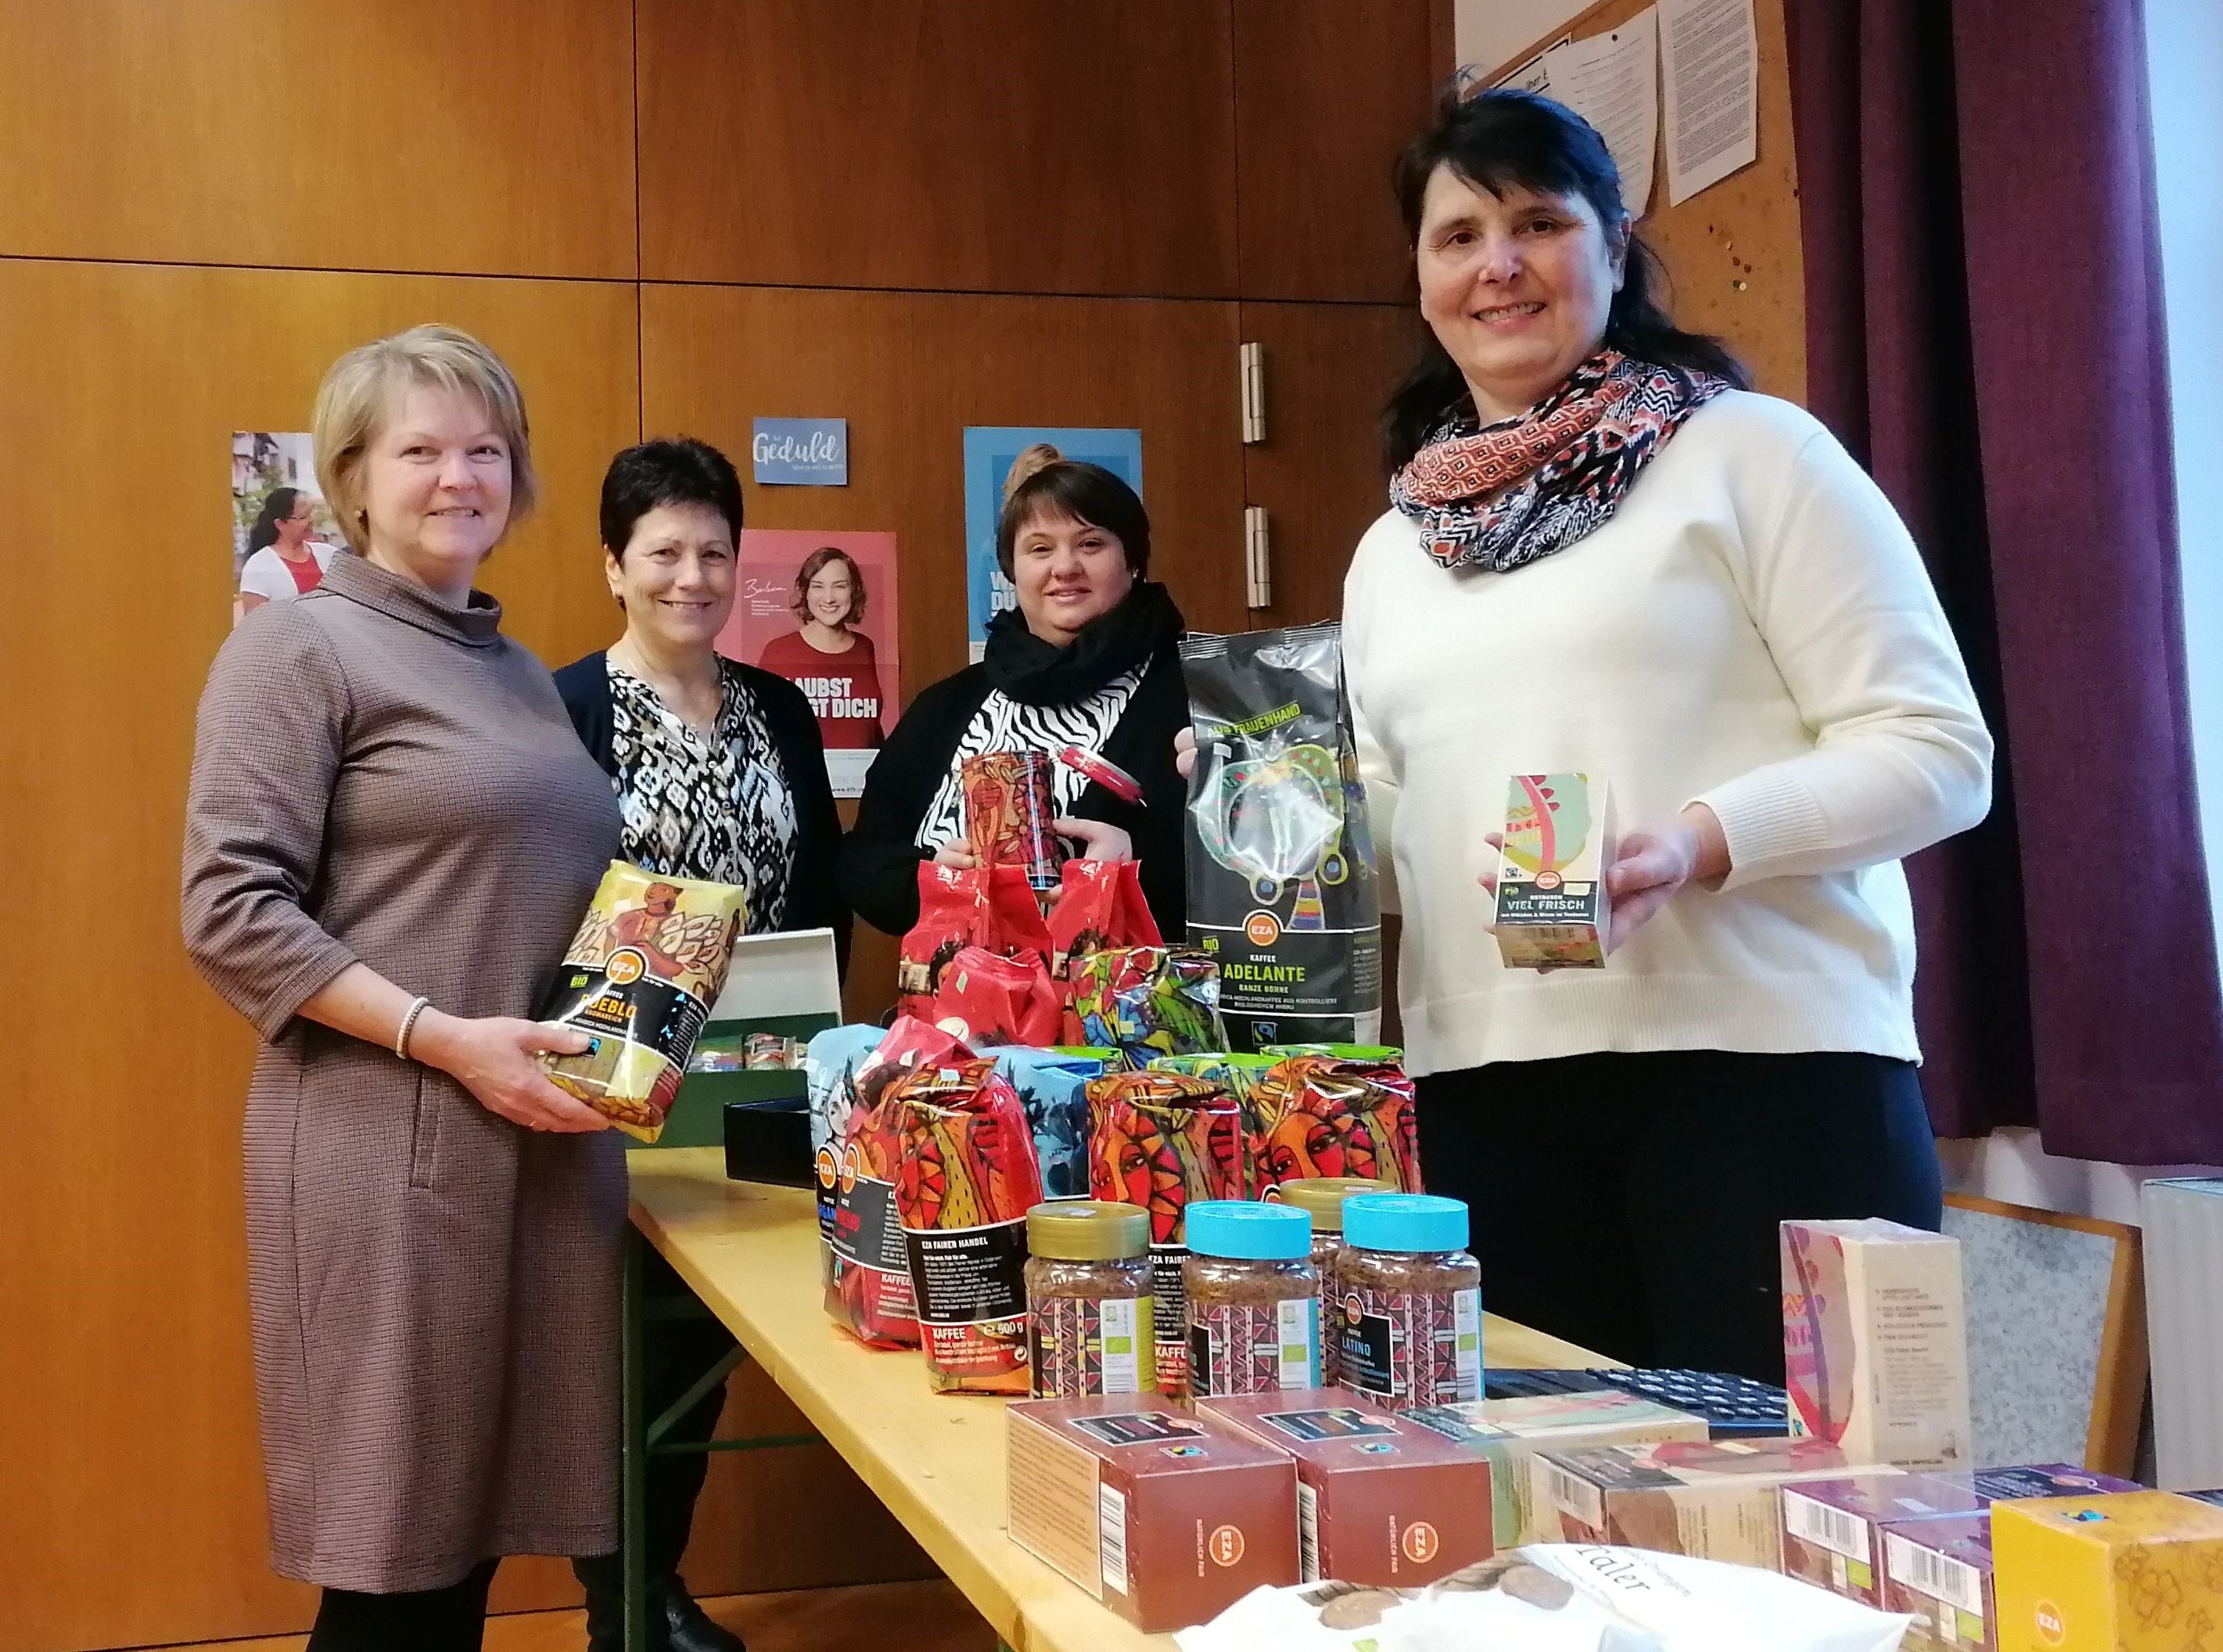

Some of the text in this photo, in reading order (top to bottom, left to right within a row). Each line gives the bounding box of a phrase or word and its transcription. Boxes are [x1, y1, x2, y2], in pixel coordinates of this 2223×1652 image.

[752, 431, 840, 465] Geduld
[831, 699, 878, 718] DICH
[1507, 900, 1585, 910] VIEL FRISCH
[1251, 925, 1273, 936] EZA
[612, 961, 636, 975] EZA
[1224, 964, 1306, 982] ADELANTE
[572, 976, 588, 987] BIO
[958, 1237, 989, 1248] HANDEL
[932, 1327, 966, 1340] KAFFEE
[1341, 1336, 1371, 1357] LATINO
[1221, 1531, 1233, 1560] EZA
[1414, 1527, 1427, 1557] EZA
[1575, 1546, 1650, 1590] Taler
[2038, 1612, 2062, 1633] EZA
